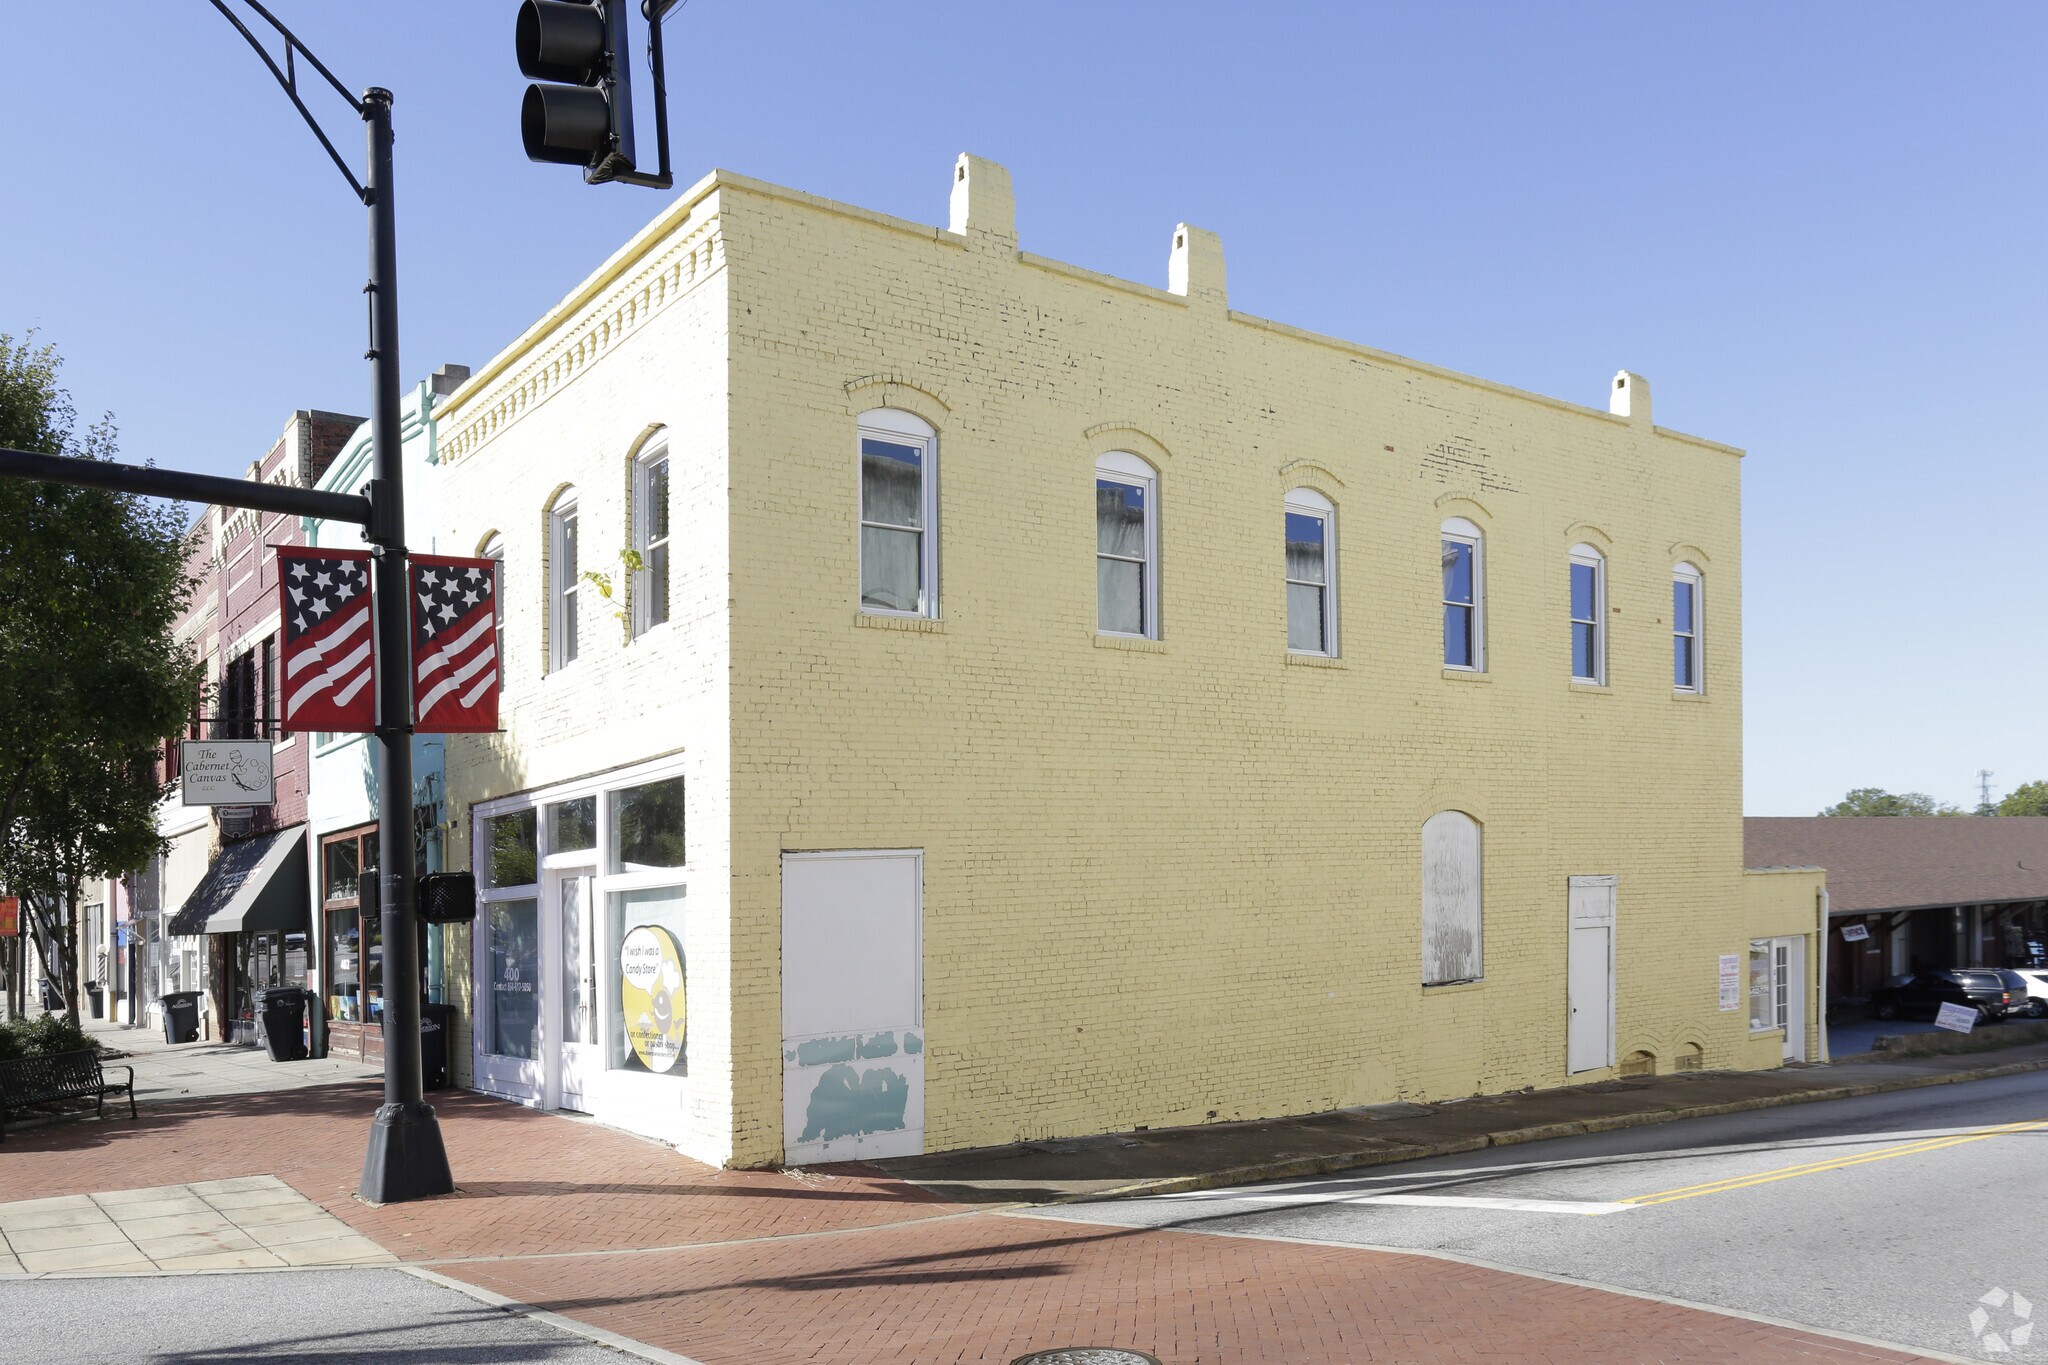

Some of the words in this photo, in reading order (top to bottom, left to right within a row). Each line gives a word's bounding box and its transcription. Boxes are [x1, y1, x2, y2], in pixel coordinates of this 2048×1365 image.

[198, 748, 217, 759] The
[185, 760, 230, 772] Cabernet
[189, 773, 227, 784] Canvas
[630, 945, 641, 956] wish
[503, 967, 520, 981] 400
[626, 963, 642, 976] Candy
